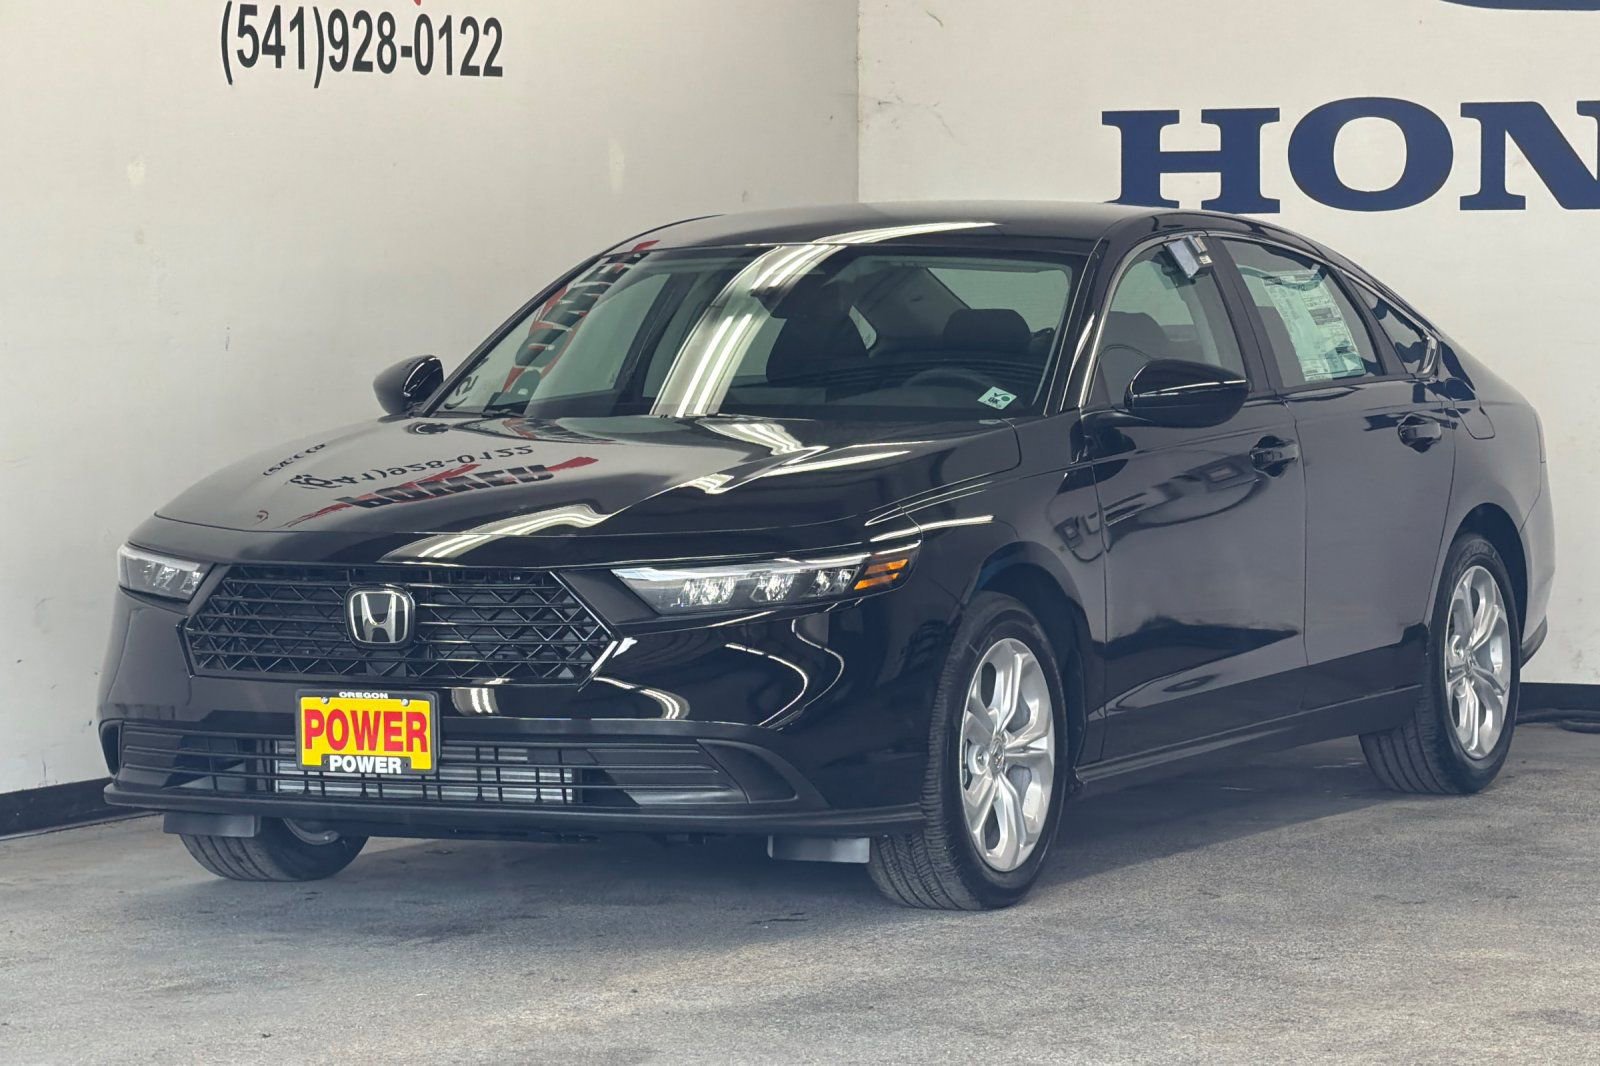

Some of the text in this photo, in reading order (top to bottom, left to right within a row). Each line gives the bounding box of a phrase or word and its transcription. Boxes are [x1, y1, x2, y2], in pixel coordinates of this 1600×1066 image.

[221, 0, 503, 89] (541)928-0122
[338, 691, 389, 699] OREGON
[304, 708, 428, 753] POWER
[329, 755, 402, 774] POWER
